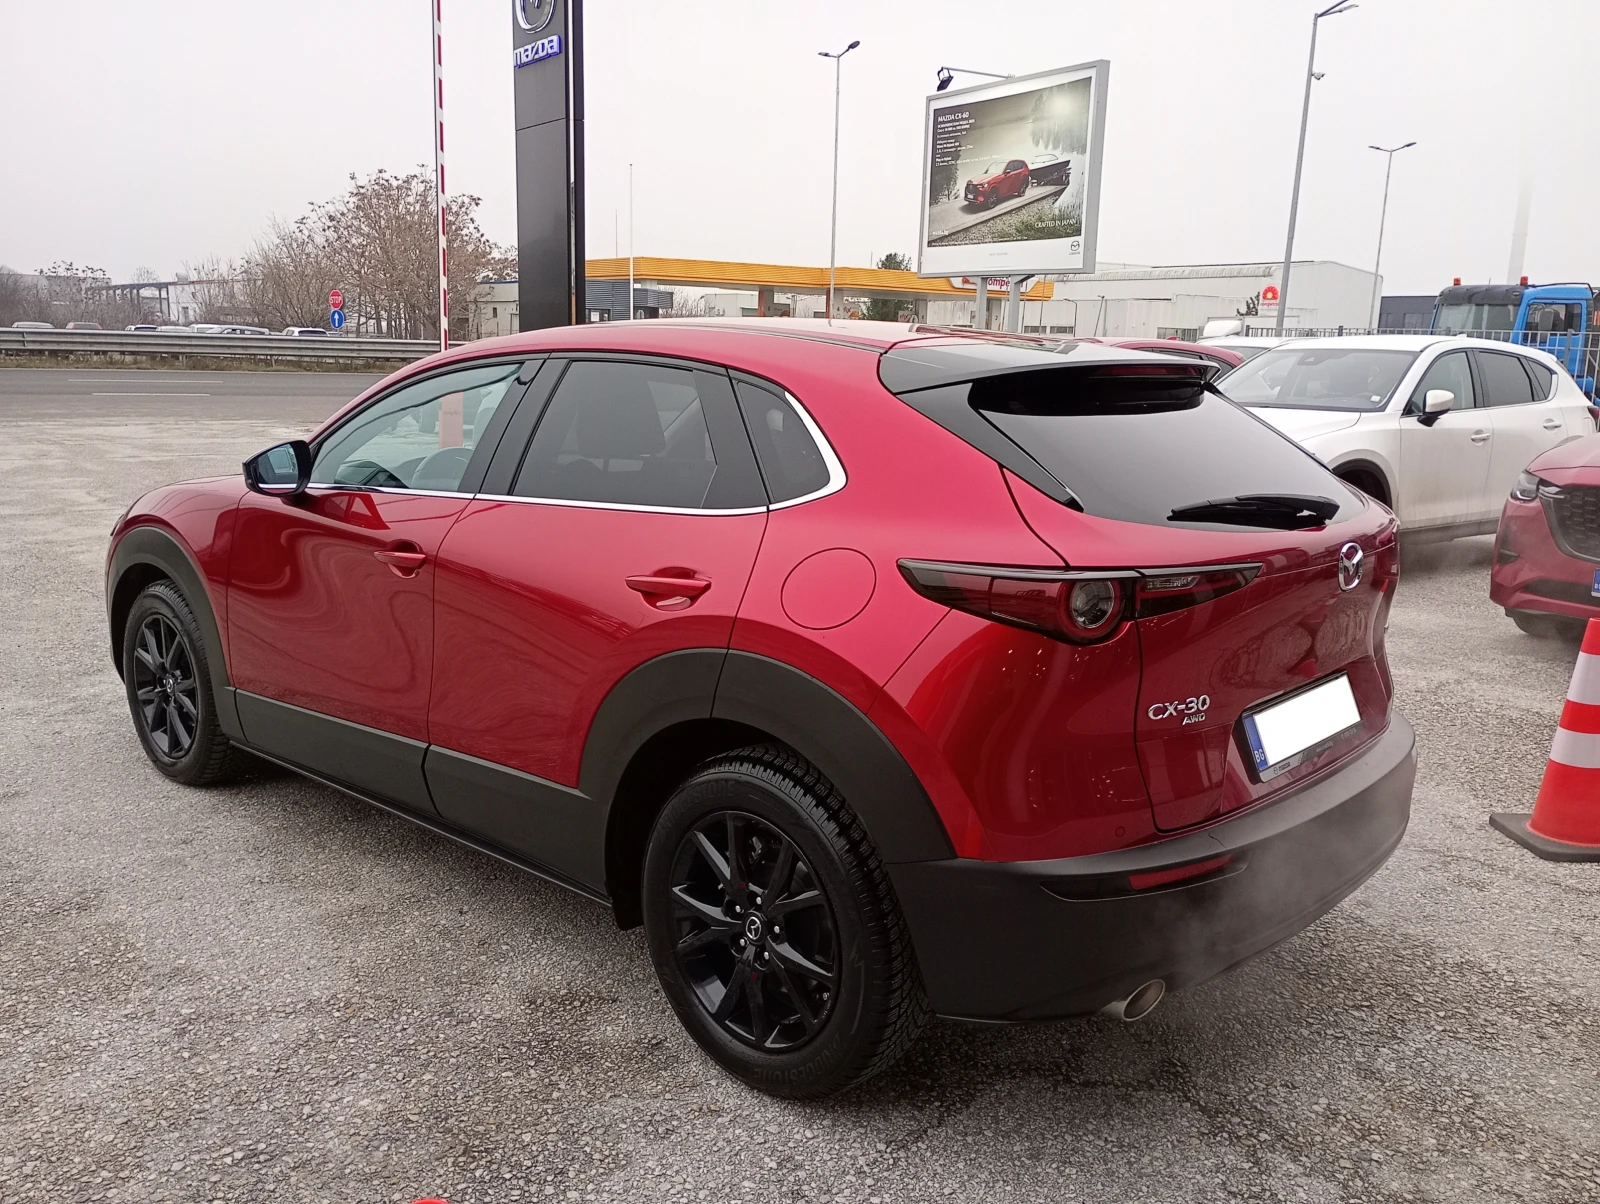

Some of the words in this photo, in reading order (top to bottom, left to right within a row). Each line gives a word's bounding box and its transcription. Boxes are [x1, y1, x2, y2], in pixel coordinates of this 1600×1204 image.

[513, 34, 562, 68] mazda
[937, 113, 955, 122] MAZDA
[955, 111, 970, 119] CX-60
[1034, 220, 1056, 228] CRAFTED
[330, 295, 343, 304] STOP
[1147, 694, 1211, 720] CX-30
[1182, 712, 1206, 726] AWD
[1254, 748, 1265, 763] BG
